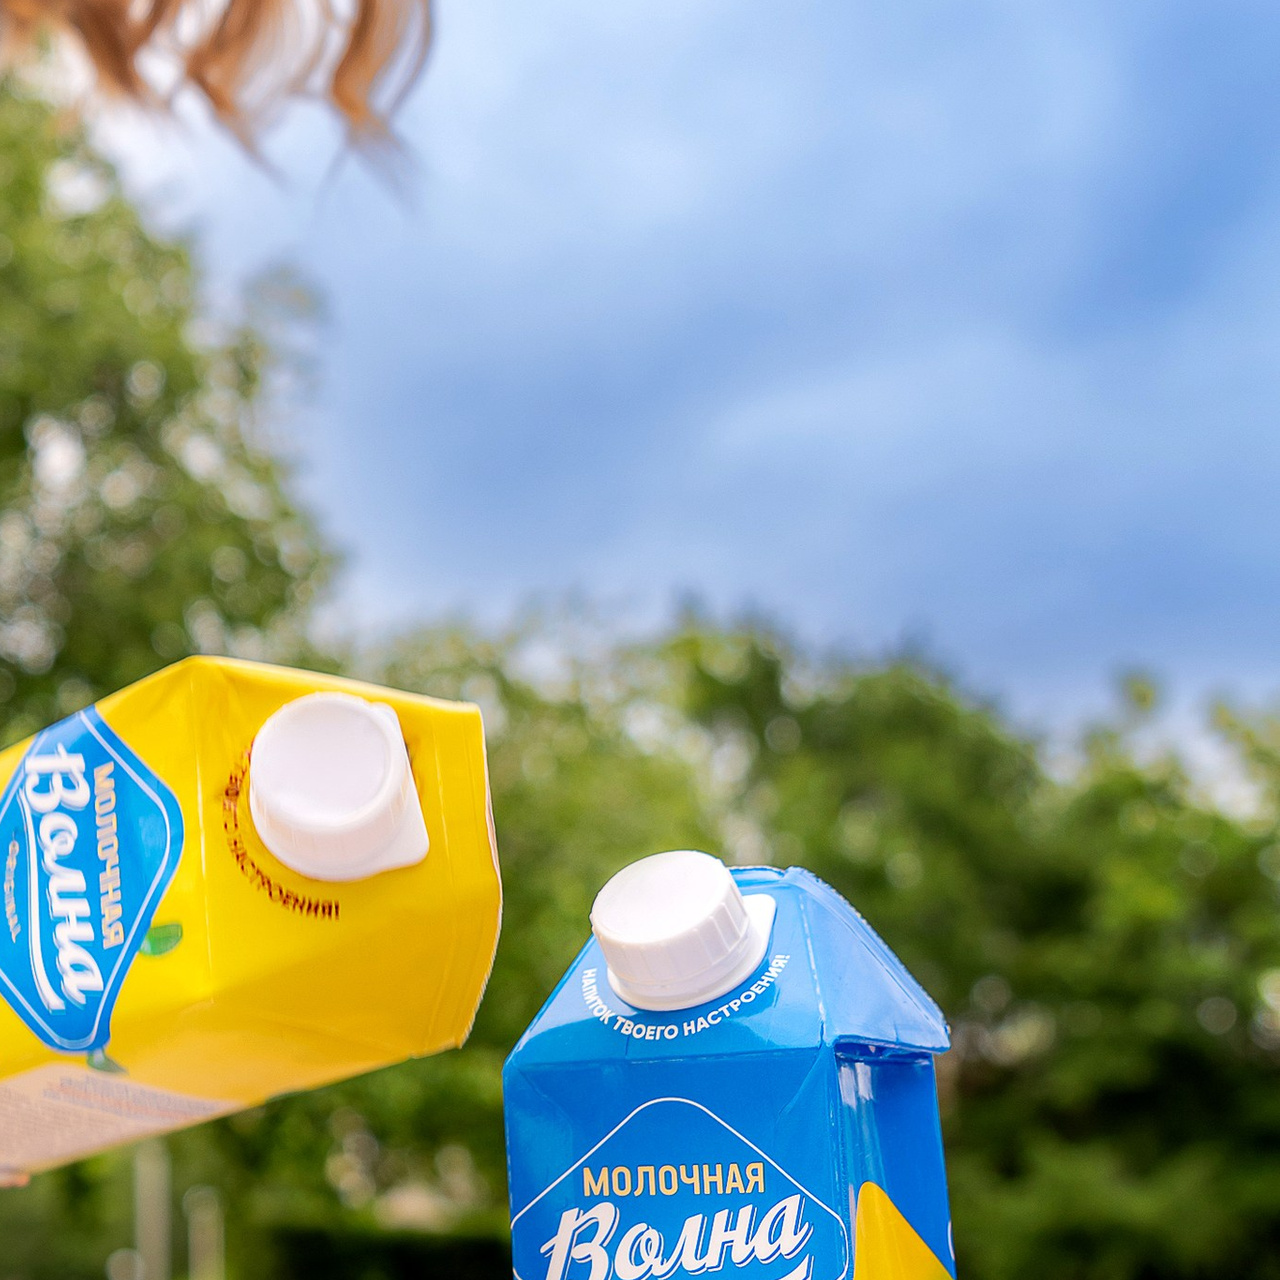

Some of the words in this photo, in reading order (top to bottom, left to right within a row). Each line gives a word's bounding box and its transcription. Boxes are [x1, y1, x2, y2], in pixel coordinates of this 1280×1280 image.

[21, 742, 104, 1008] Волна
[93, 760, 124, 950] МОЛОЧНАЯ
[582, 968, 615, 1024] НАПИТОК
[613, 1015, 679, 1041] ТВОЕГО
[683, 954, 791, 1037] НАСТРОЕНИЯ!
[582, 1162, 766, 1198] МОЛОЧНАЯ
